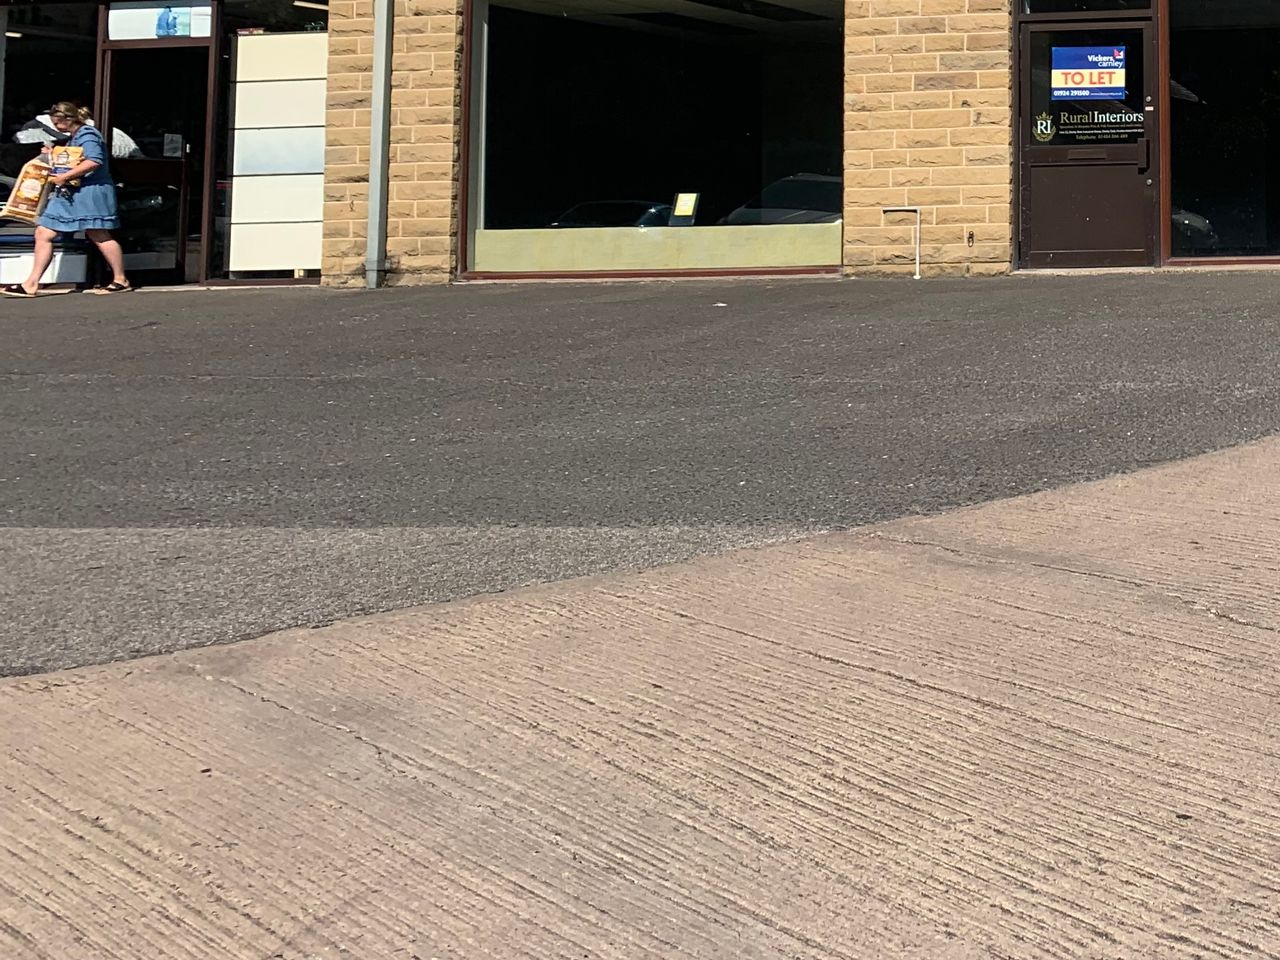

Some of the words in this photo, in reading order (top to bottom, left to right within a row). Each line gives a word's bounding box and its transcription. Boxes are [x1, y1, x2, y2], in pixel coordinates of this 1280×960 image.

[1087, 54, 1115, 62] Vickers
[1098, 59, 1124, 69] carnley
[1061, 71, 1085, 86] TO
[1089, 71, 1116, 85] LET
[1037, 120, 1051, 134] RI
